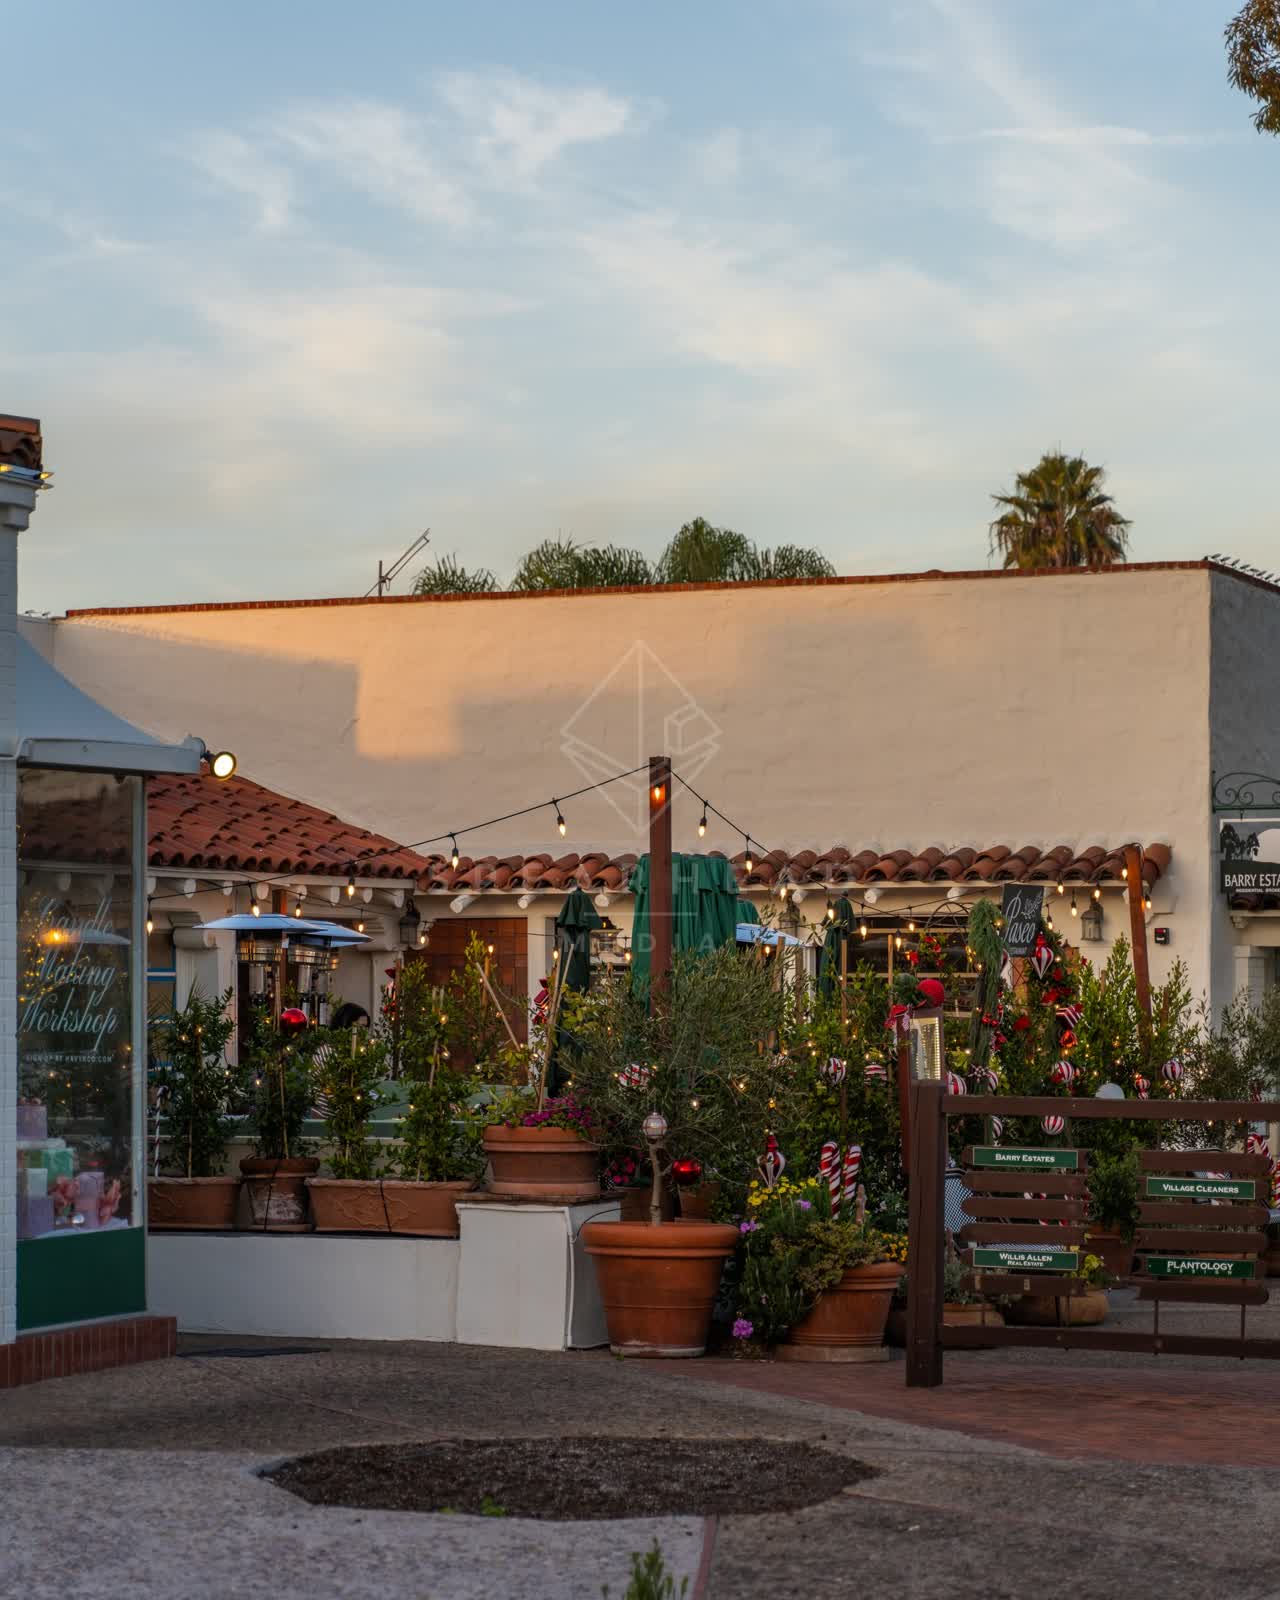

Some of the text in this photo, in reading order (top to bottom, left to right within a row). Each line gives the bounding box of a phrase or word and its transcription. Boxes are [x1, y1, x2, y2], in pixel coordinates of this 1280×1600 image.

[1224, 873, 1257, 887] BARRY
[38, 894, 114, 937] Candle
[1003, 889, 1036, 944] Paseo
[39, 942, 115, 1006] Making
[17, 988, 119, 1052] Workshop
[995, 1153, 1055, 1163] BARRY ESTATES
[1162, 1183, 1239, 1194] VILLAGE CLEANERS
[999, 1252, 1053, 1262] WILLIS ALLEN
[1167, 1261, 1234, 1270] PLANTOLOGY
